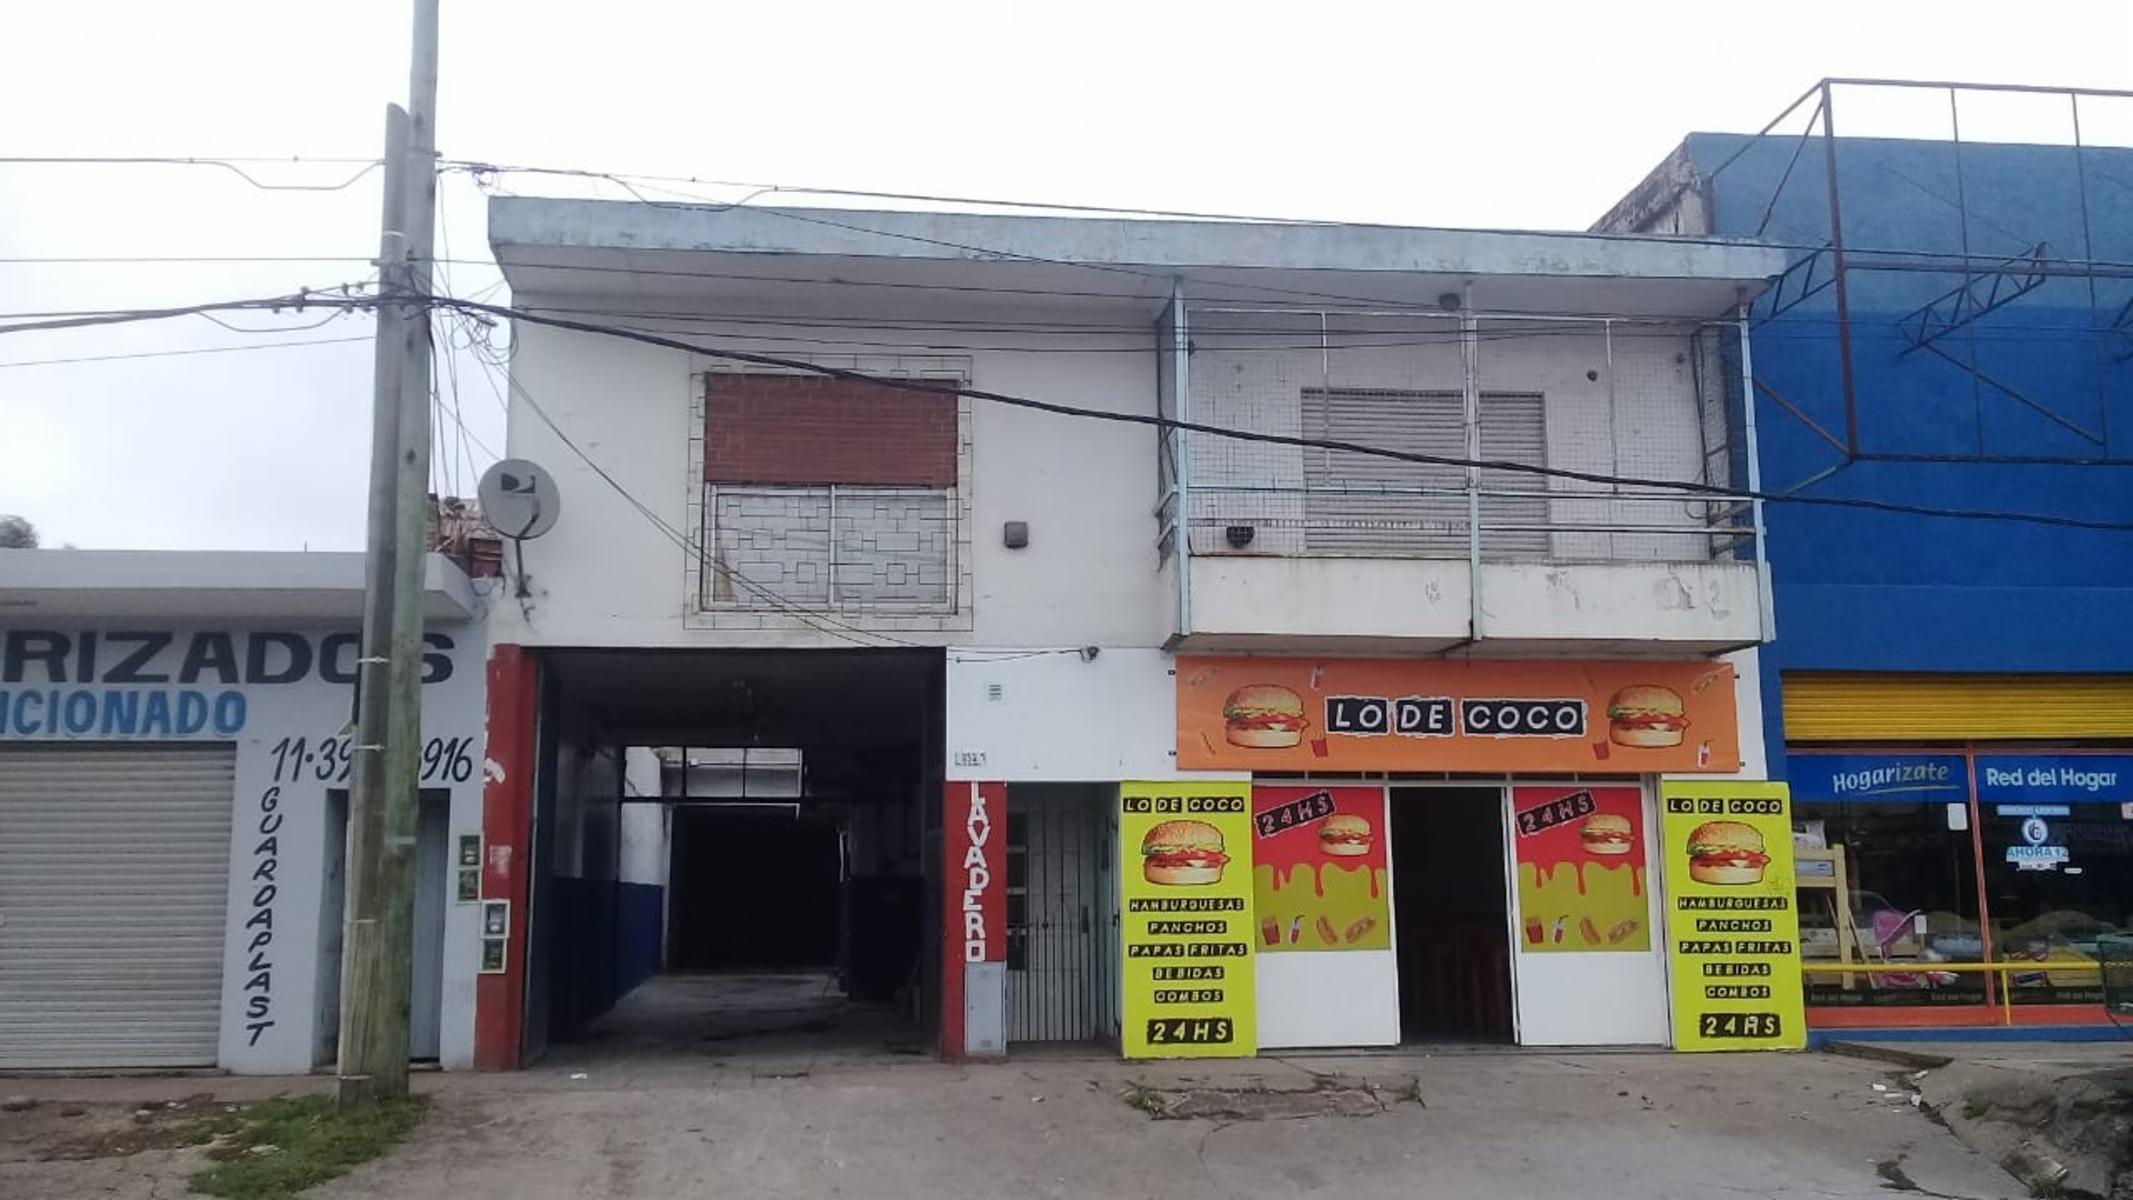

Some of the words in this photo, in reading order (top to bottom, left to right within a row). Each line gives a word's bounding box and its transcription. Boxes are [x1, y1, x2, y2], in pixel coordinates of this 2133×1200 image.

[1335, 702, 1383, 728] LO
[1399, 703, 1445, 729] DE
[1468, 705, 1578, 730] COCO
[1832, 762, 1949, 794] Hogarizate
[1987, 766, 2023, 787] Red
[2026, 766, 2056, 787] del
[2060, 768, 2117, 792] Hogar
[1125, 798, 1150, 812] LO
[1156, 798, 1181, 812] DE
[1188, 798, 1243, 812] COCO
[1669, 800, 1693, 813] LO
[1699, 799, 1721, 813] DE
[1729, 800, 1782, 813] COCO
[962, 781, 991, 963] LAVADERO
[1130, 898, 1242, 911] HAMBURGUESAS
[1679, 897, 1786, 909] HAMBURGUESAS
[1149, 921, 1225, 933] PANCHOS
[1698, 920, 1770, 931] PANCHOS
[1129, 945, 1183, 957] PAPAS
[1189, 944, 1247, 956] FRITAS
[1680, 942, 1730, 953] PAPAS
[1737, 942, 1790, 953] FRITAS
[1154, 967, 1222, 980] BEBIDAS
[1705, 964, 1769, 975] BEBIDAS
[1154, 990, 1222, 1002] COMBOS
[1706, 986, 1768, 998] COMBOS
[1152, 1020, 1229, 1041] 24HS
